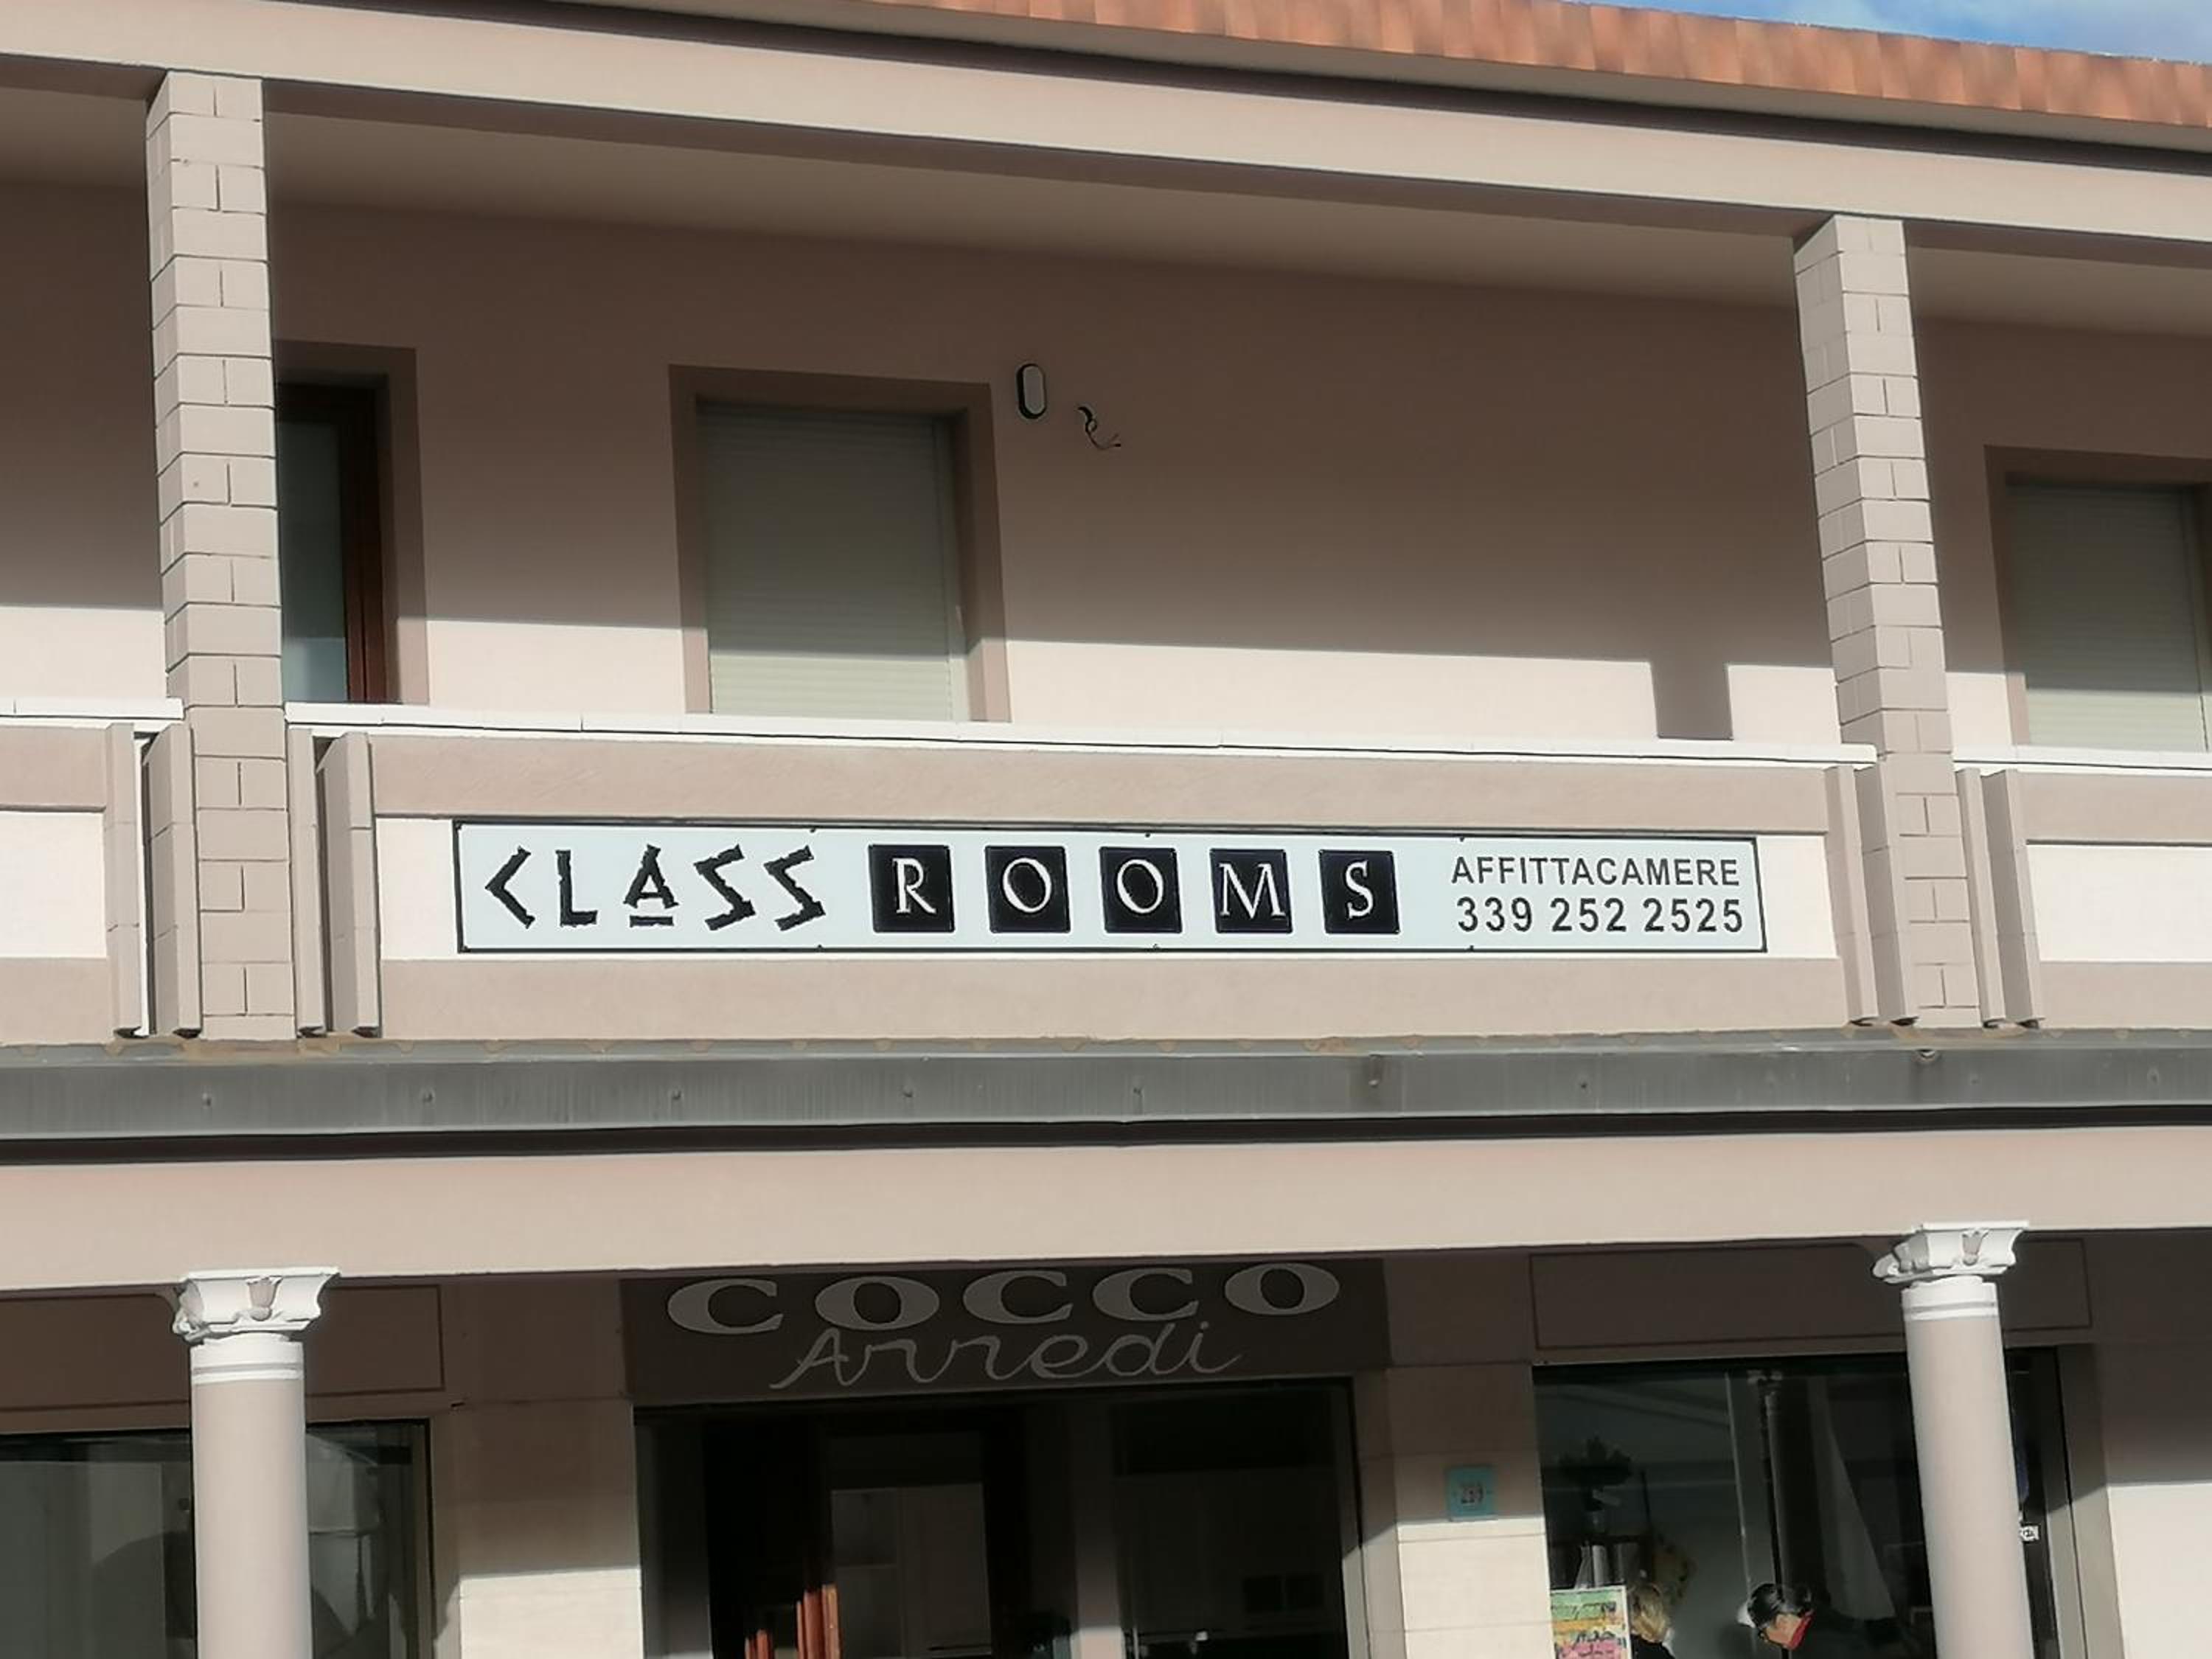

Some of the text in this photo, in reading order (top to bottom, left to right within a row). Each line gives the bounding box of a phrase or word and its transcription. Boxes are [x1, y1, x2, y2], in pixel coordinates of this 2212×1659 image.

[484, 844, 1374, 931] CLASS ROOMS
[1451, 857, 1739, 886] AFFITTACAMERE
[1457, 897, 1742, 932] 339 252 2525
[667, 1263, 1340, 1334] COCCO
[769, 1321, 1243, 1389] Arredi
